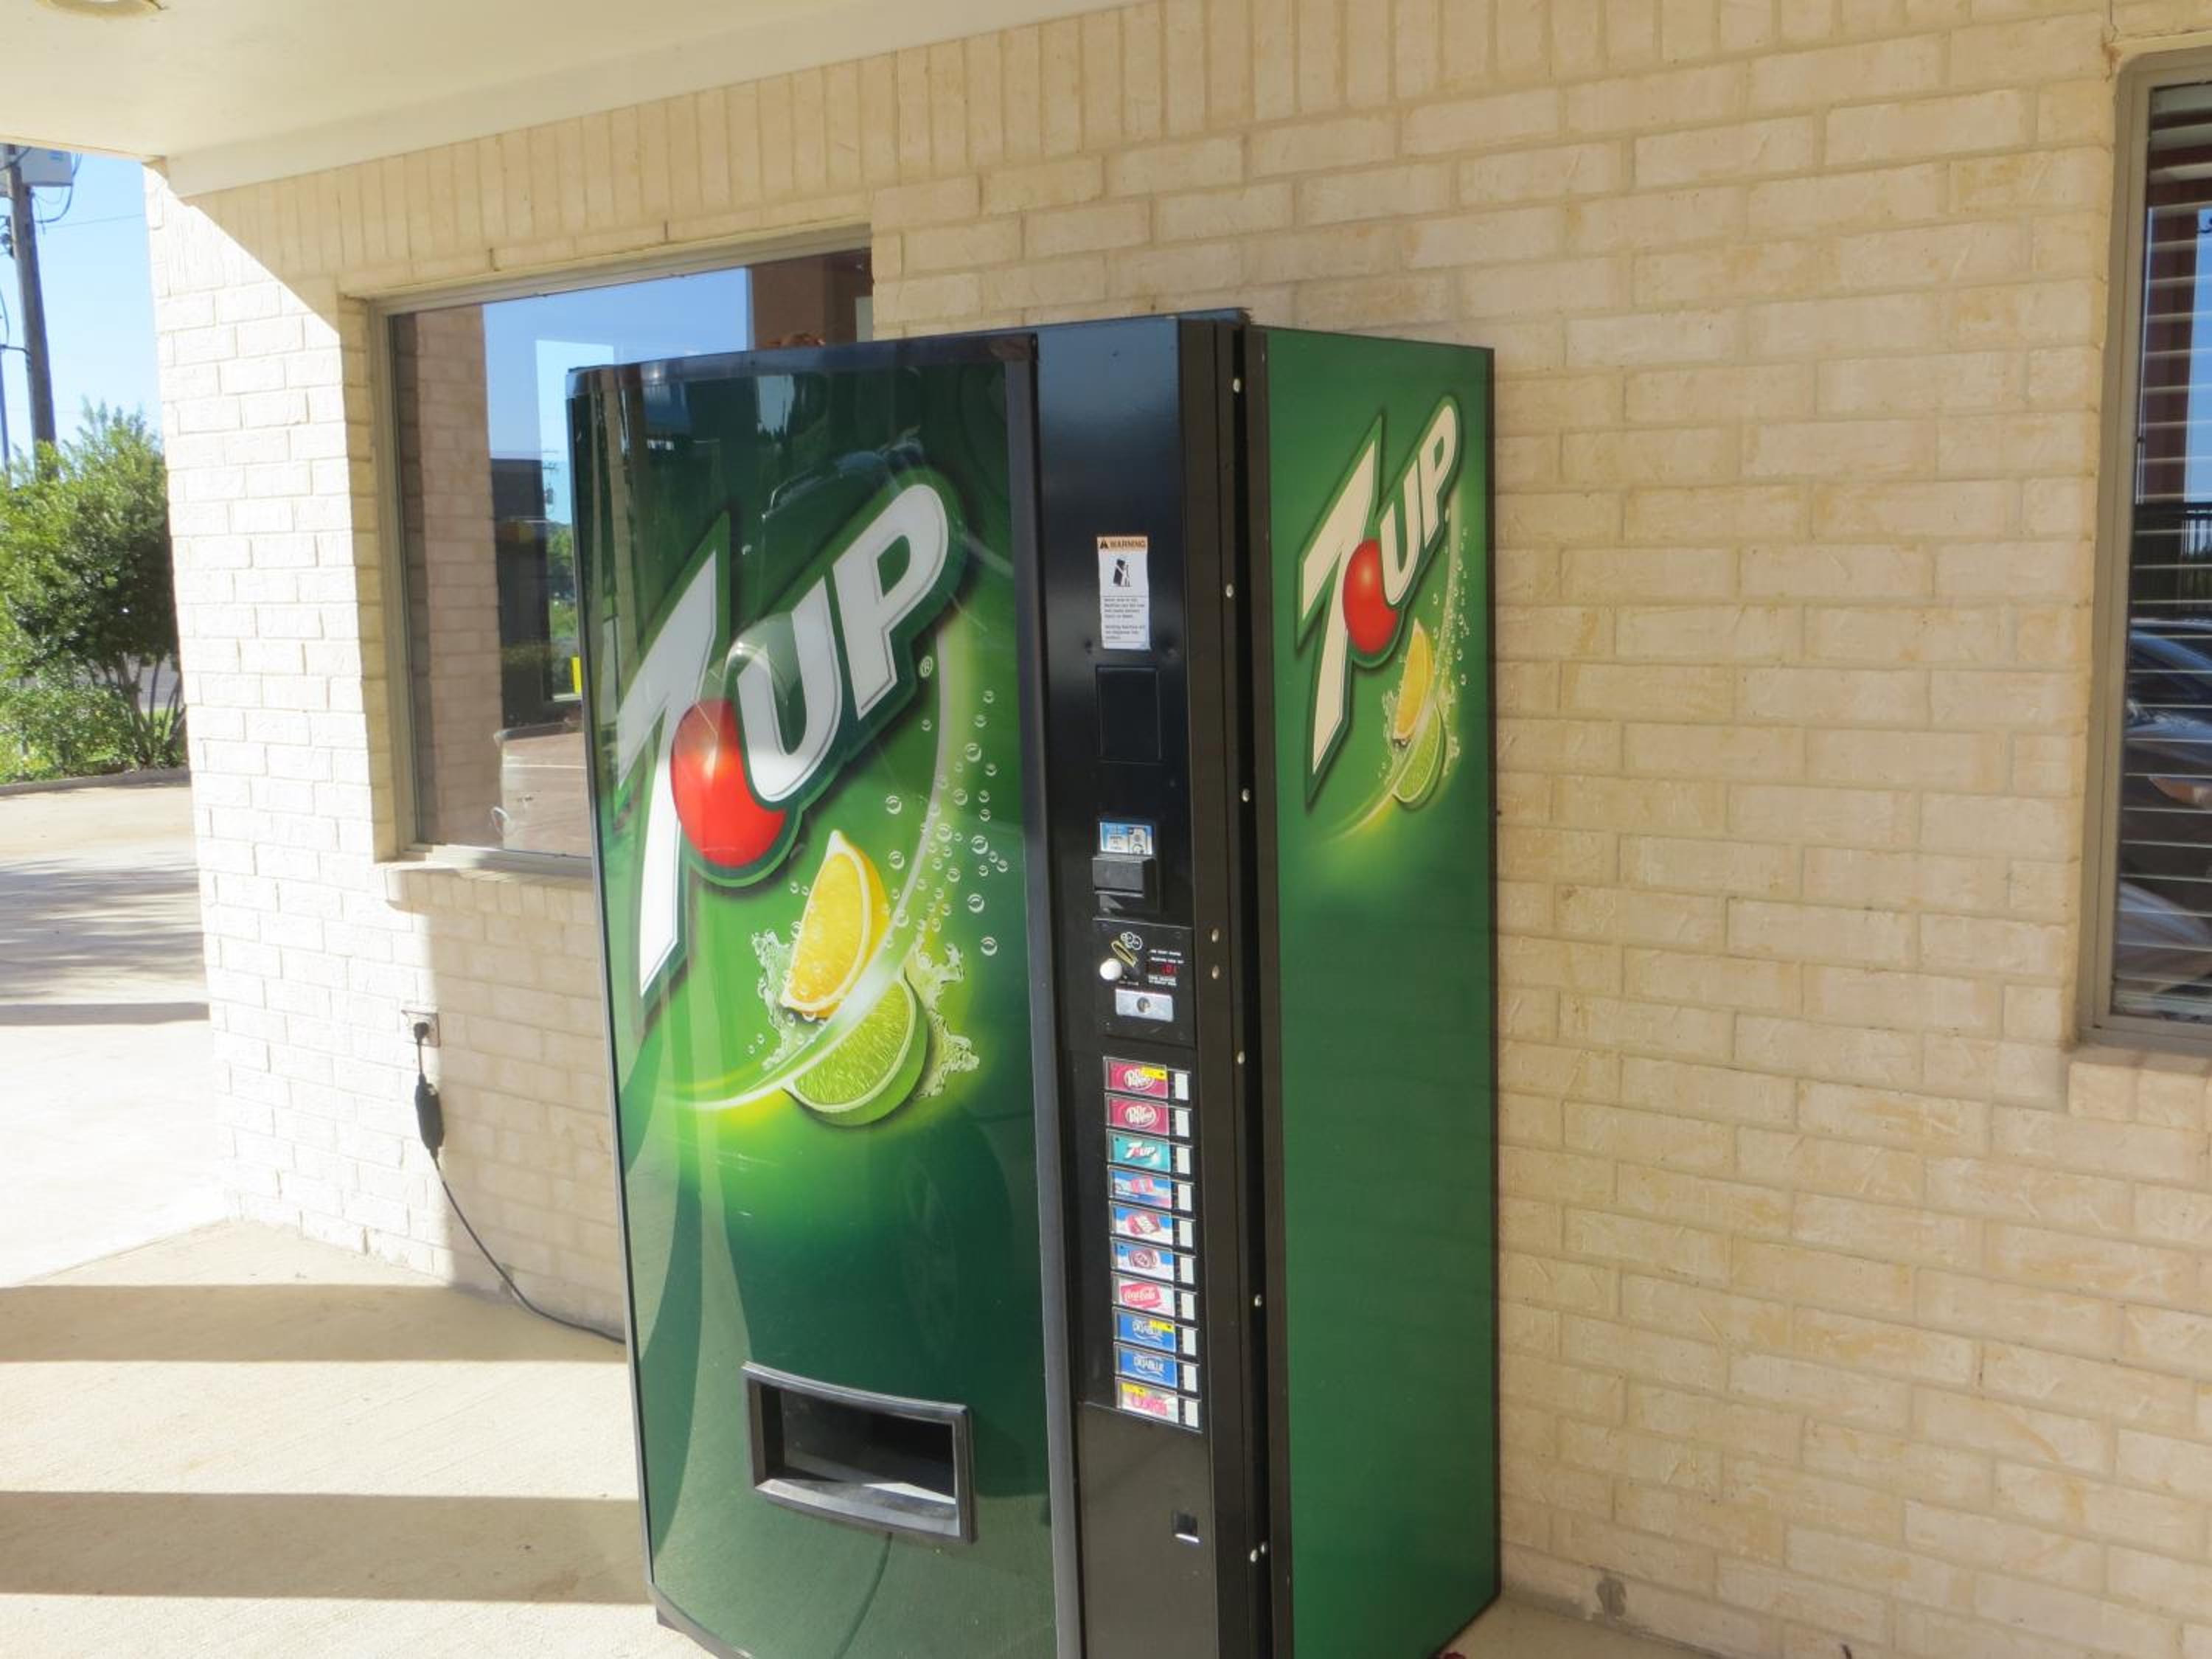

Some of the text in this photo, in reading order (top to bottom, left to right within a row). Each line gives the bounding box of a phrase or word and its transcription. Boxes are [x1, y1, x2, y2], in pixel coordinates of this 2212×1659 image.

[1110, 540, 1145, 549] WARNING
[1302, 403, 1458, 775] 7UP
[617, 484, 948, 998] 7UP
